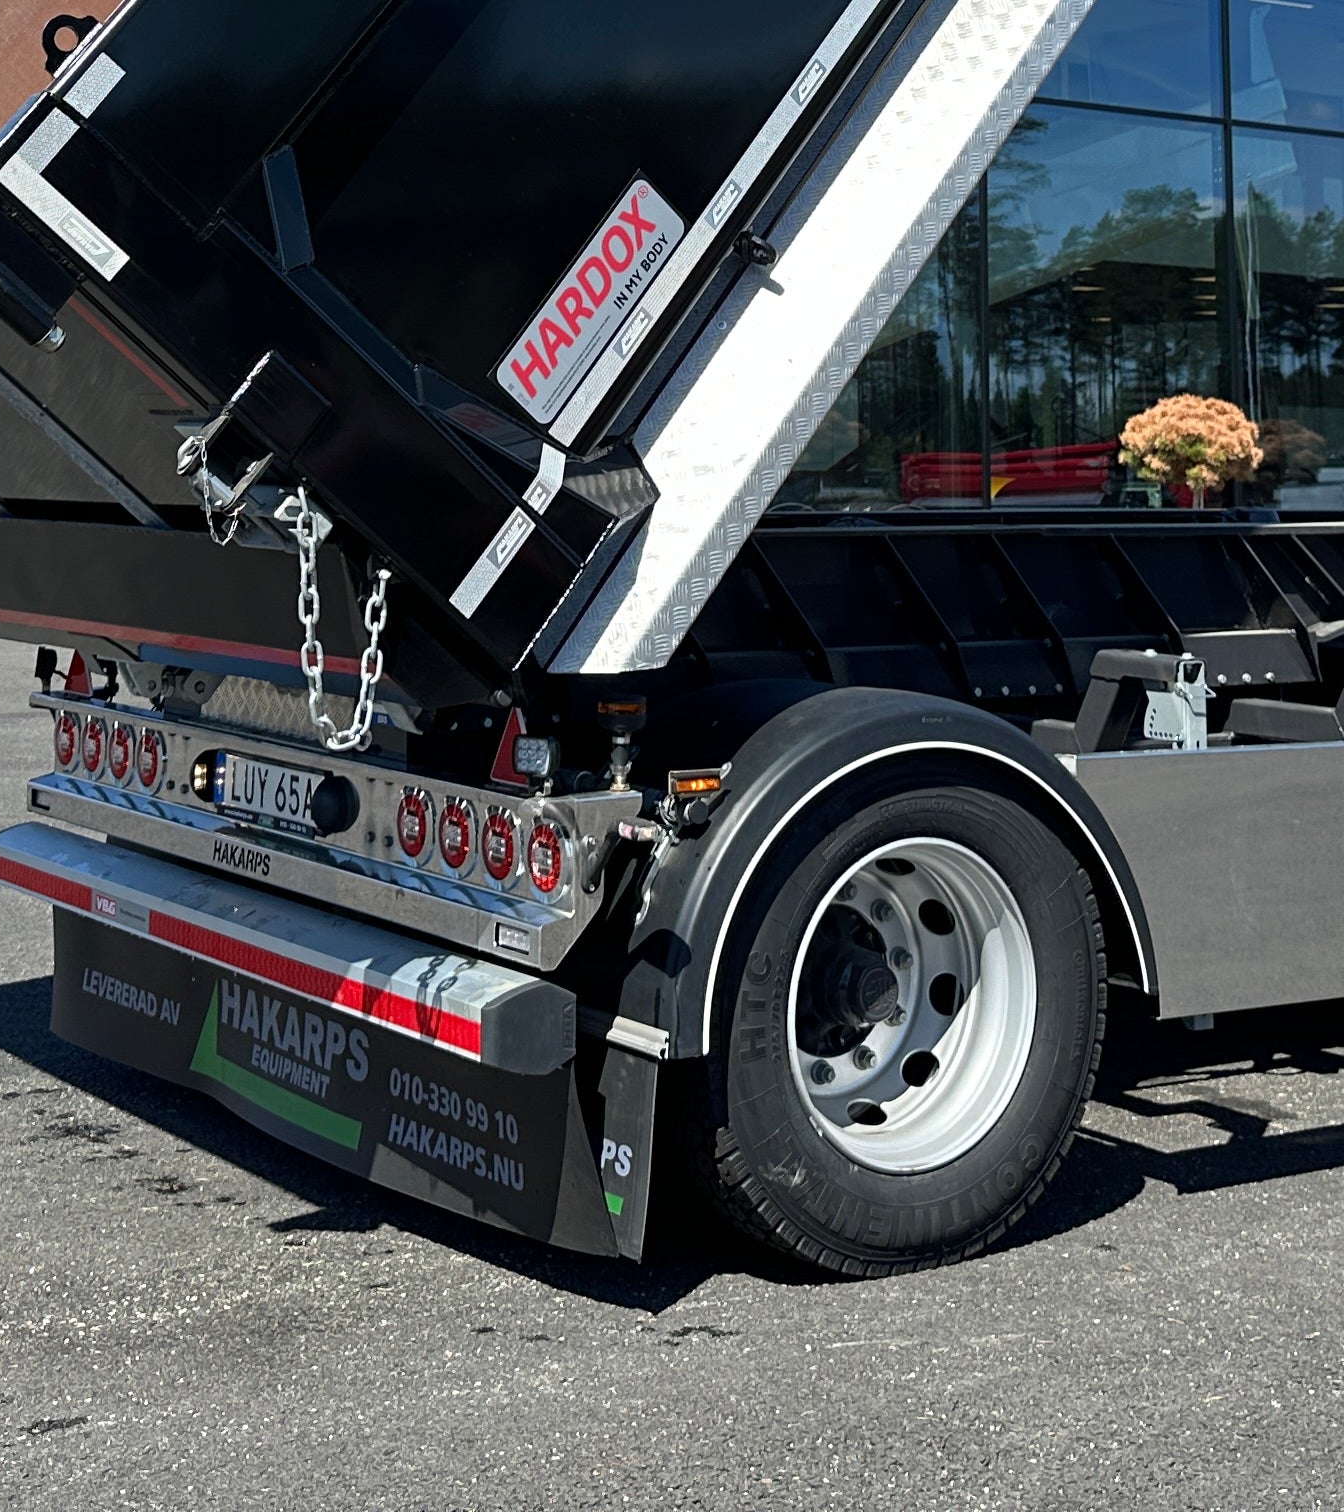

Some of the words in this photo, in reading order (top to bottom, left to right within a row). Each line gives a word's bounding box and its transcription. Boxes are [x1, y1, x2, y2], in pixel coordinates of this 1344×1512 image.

[510, 194, 656, 399] HARDOX
[613, 291, 628, 310] IN
[625, 271, 643, 295] MY
[640, 232, 669, 272] BODY
[231, 761, 268, 808] LUY
[212, 840, 271, 877] HAKARPS
[96, 896, 116, 916] VBG
[82, 968, 157, 1018] LEVERERAD
[159, 998, 181, 1026] AV
[220, 977, 370, 1082] HAKARPS
[740, 950, 772, 1065] HTC
[251, 1042, 330, 1099] EQUIPMENT
[389, 1067, 461, 1121] 010-330
[466, 1098, 489, 1133] 99
[494, 1109, 519, 1145] 10
[388, 1113, 525, 1191] HAKARPS.NU
